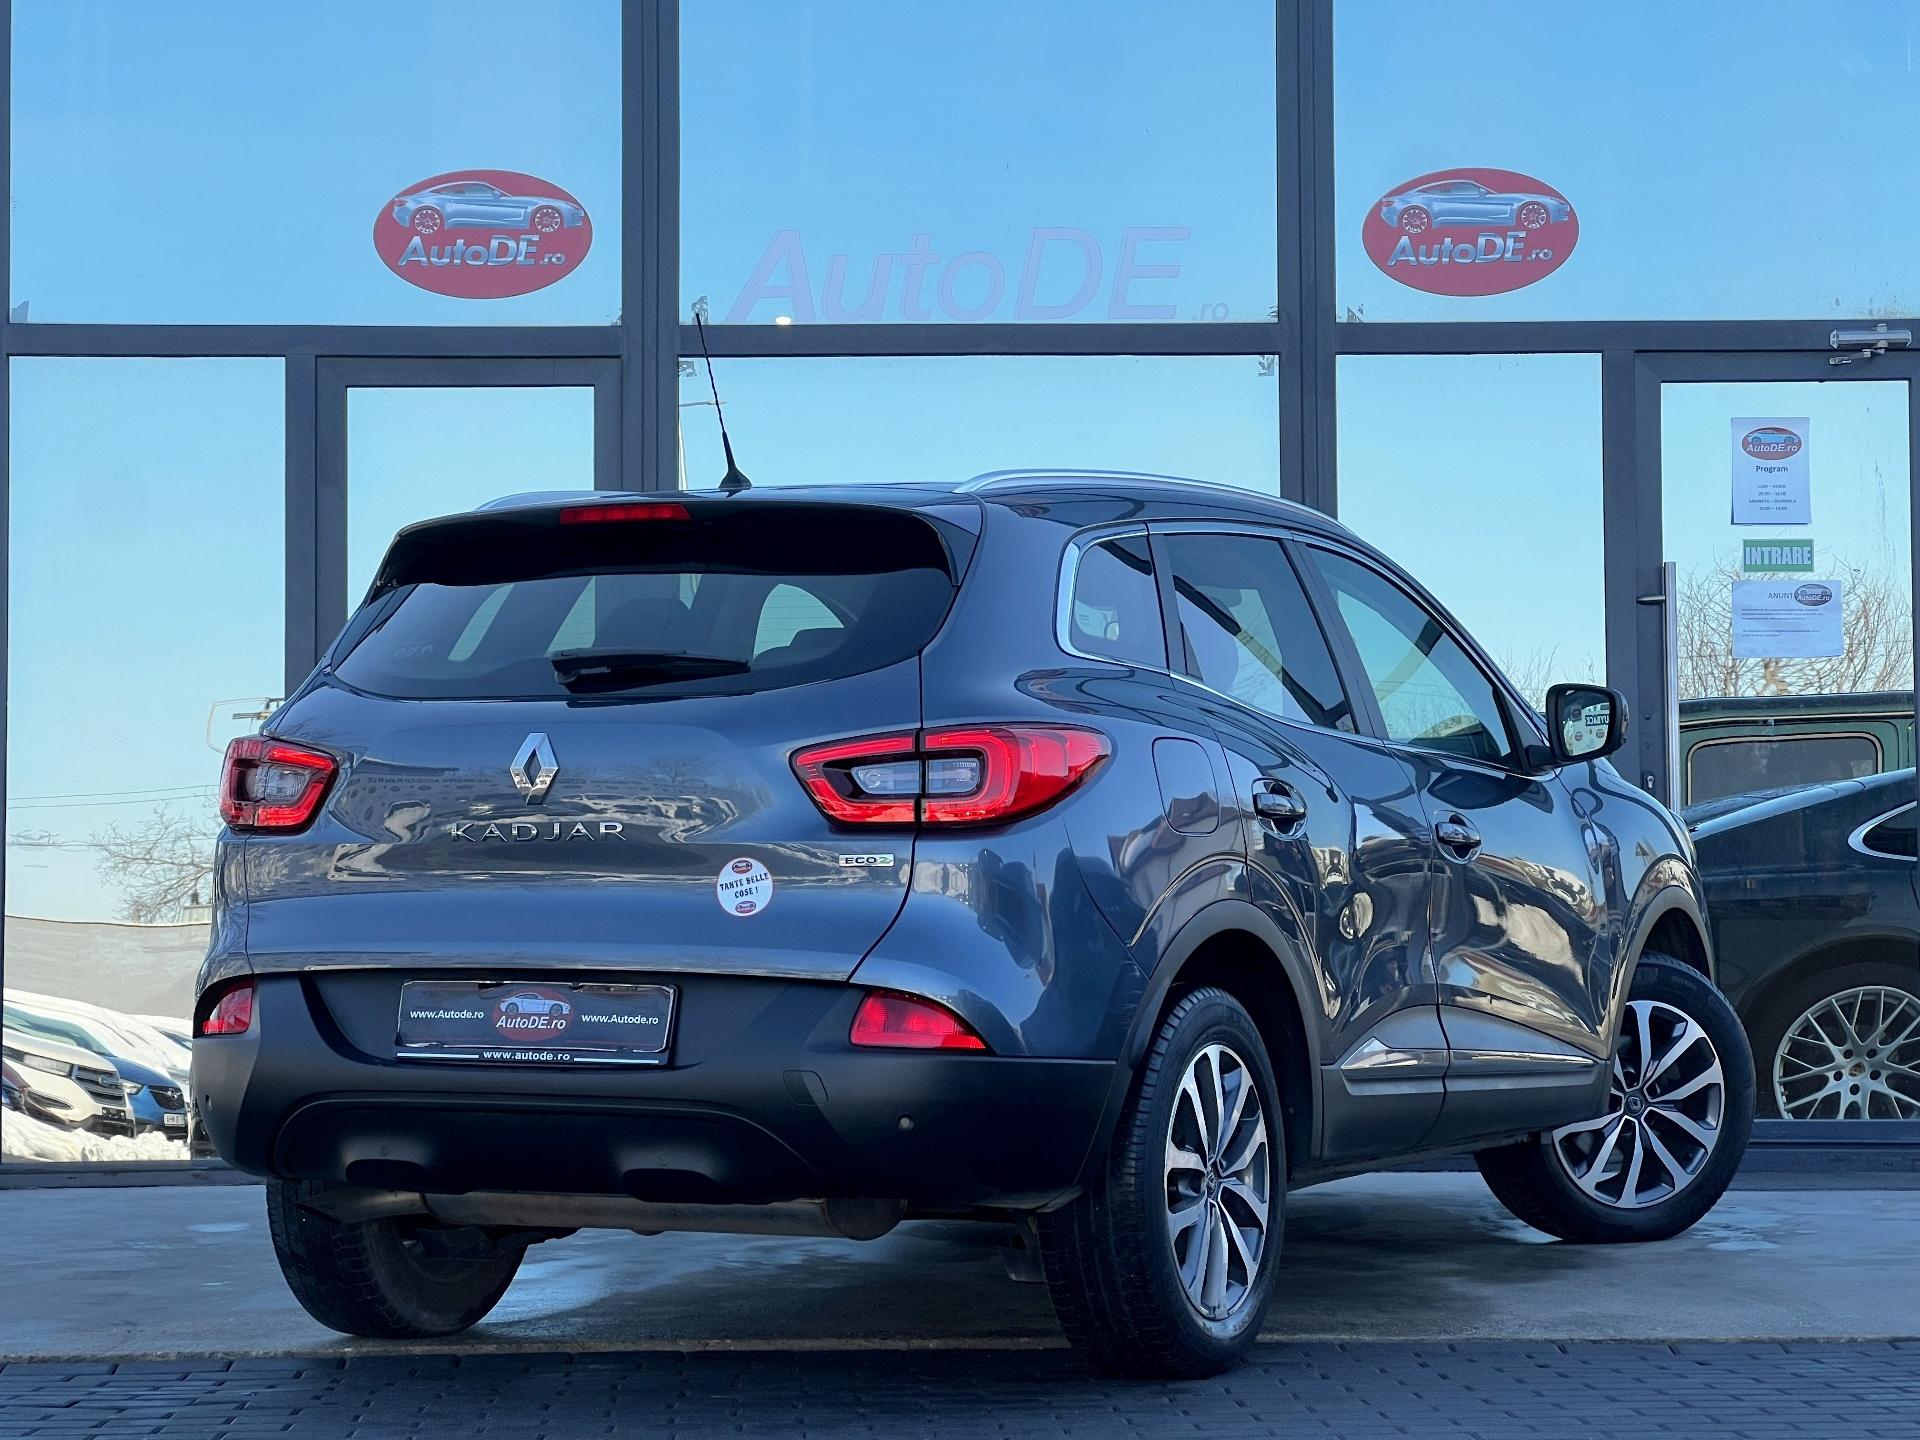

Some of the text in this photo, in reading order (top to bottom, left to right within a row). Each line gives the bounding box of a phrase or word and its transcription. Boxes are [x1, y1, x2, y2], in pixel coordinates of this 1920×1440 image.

[1746, 443, 1798, 453] AutoDE.ro
[1756, 465, 1789, 474] Program
[1745, 546, 1812, 565] INTRARE
[451, 822, 627, 842] KADJAR
[720, 872, 770, 891] TANTE BELLE
[734, 888, 754, 899] COSE
[409, 1009, 485, 1020] www.Autode.ro
[581, 1013, 659, 1025] www.Autode.ro
[496, 1015, 568, 1030] AutoDE.ro
[483, 1050, 571, 1062] www.autode.ro
